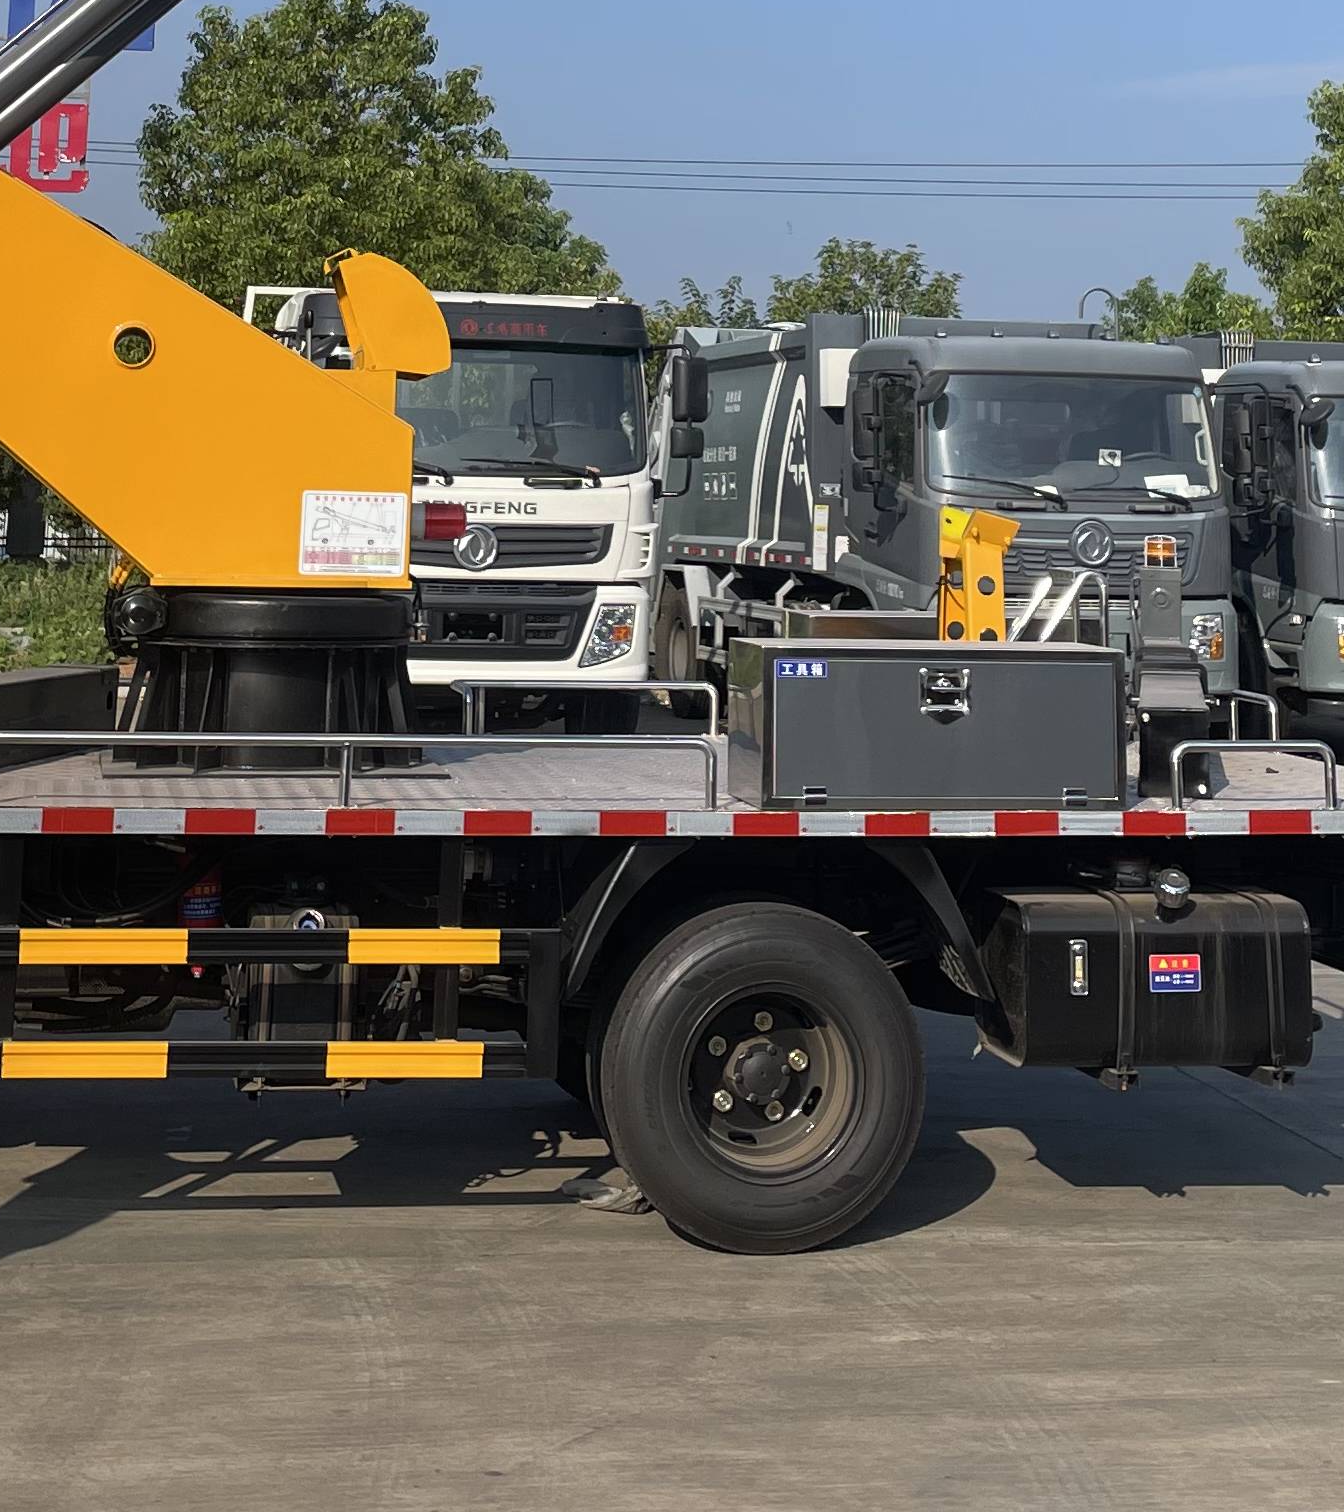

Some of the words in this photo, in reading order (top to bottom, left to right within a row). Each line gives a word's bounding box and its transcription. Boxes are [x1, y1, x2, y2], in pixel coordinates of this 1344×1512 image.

[418, 500, 537, 515] GFENG
[781, 663, 823, 676] 工具箱
